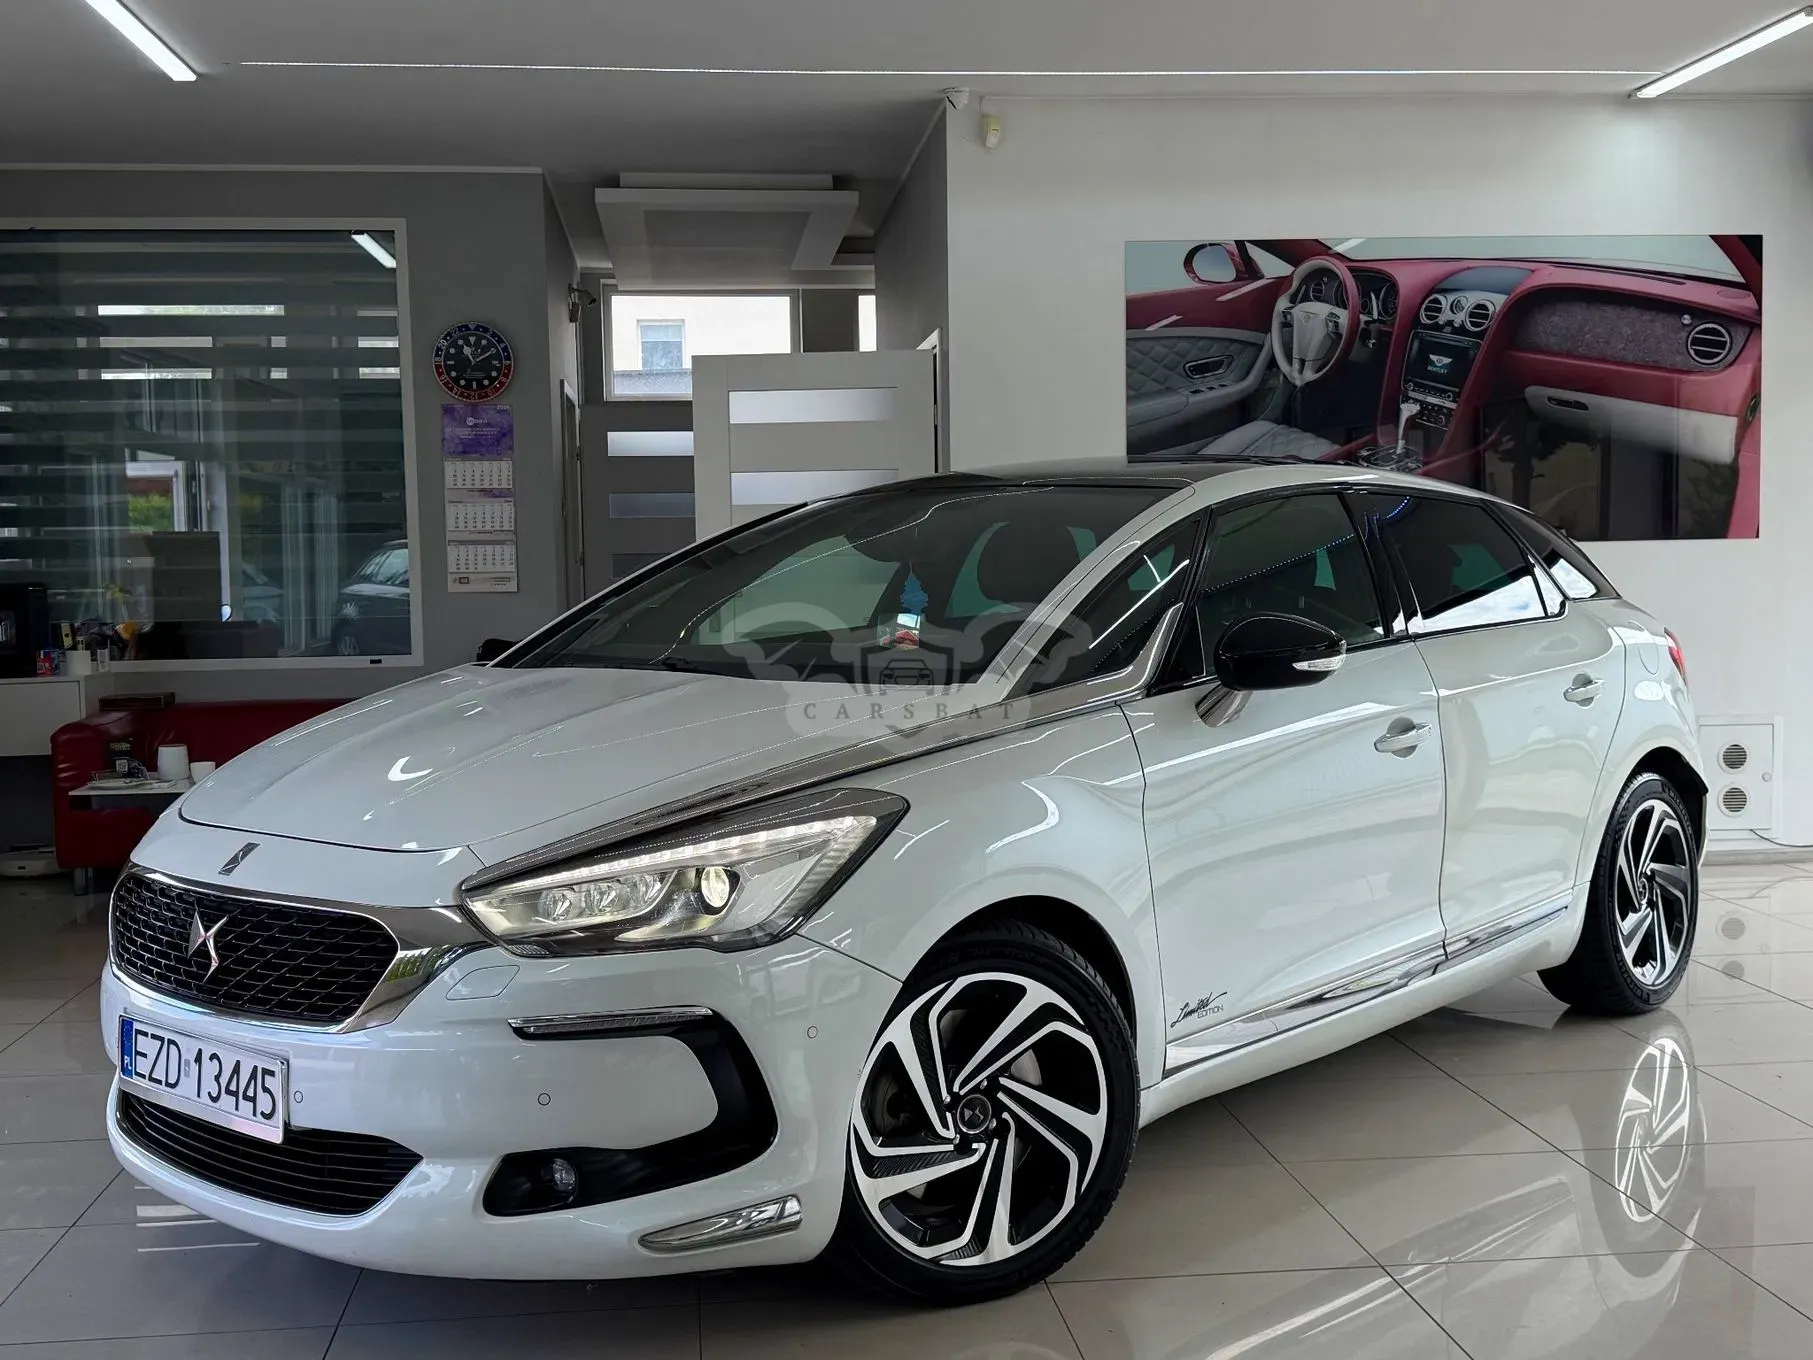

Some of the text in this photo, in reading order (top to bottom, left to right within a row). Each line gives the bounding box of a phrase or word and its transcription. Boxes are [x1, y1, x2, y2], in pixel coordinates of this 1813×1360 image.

[439, 340, 448, 349] 20
[1427, 365, 1448, 374] BENTLEY
[1197, 1005, 1224, 1019] EDITION
[123, 1055, 132, 1070] PL
[133, 1028, 276, 1120] EZD 13445
